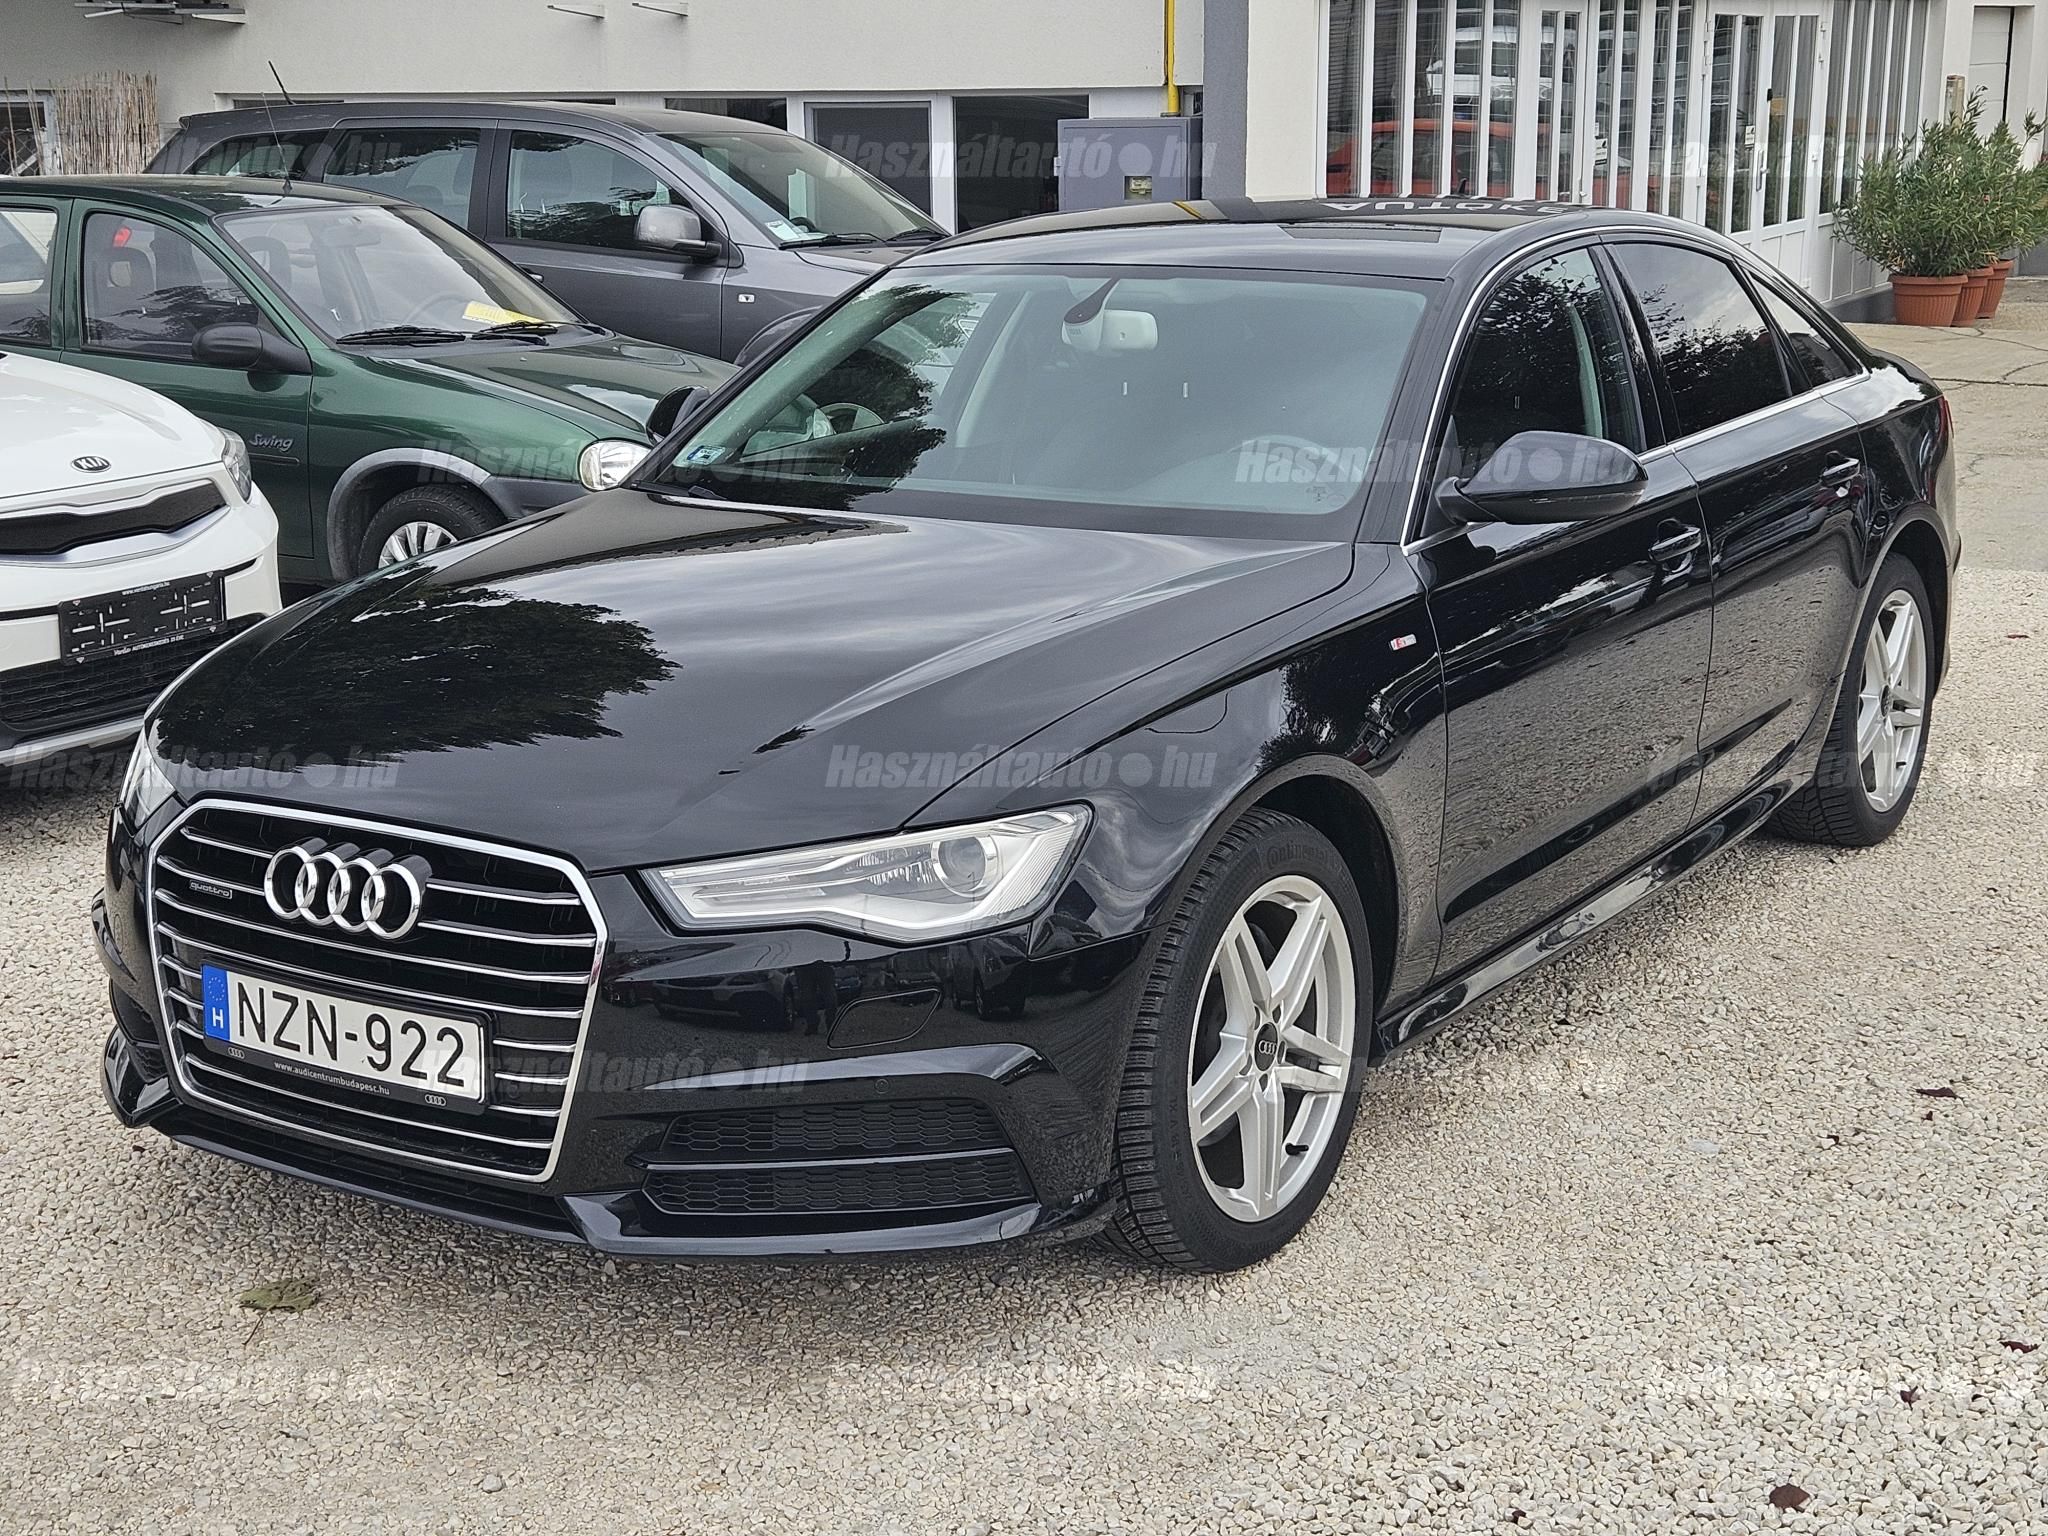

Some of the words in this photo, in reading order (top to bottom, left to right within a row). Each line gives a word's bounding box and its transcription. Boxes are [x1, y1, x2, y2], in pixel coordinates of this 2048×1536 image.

[249, 434, 294, 452] Swing
[76, 457, 108, 469] KIA
[190, 881, 230, 897] quattro
[212, 1007, 224, 1029] H
[237, 981, 465, 1088] NZN-922
[273, 1060, 391, 1096] www.audicentrumbudapest.hu
